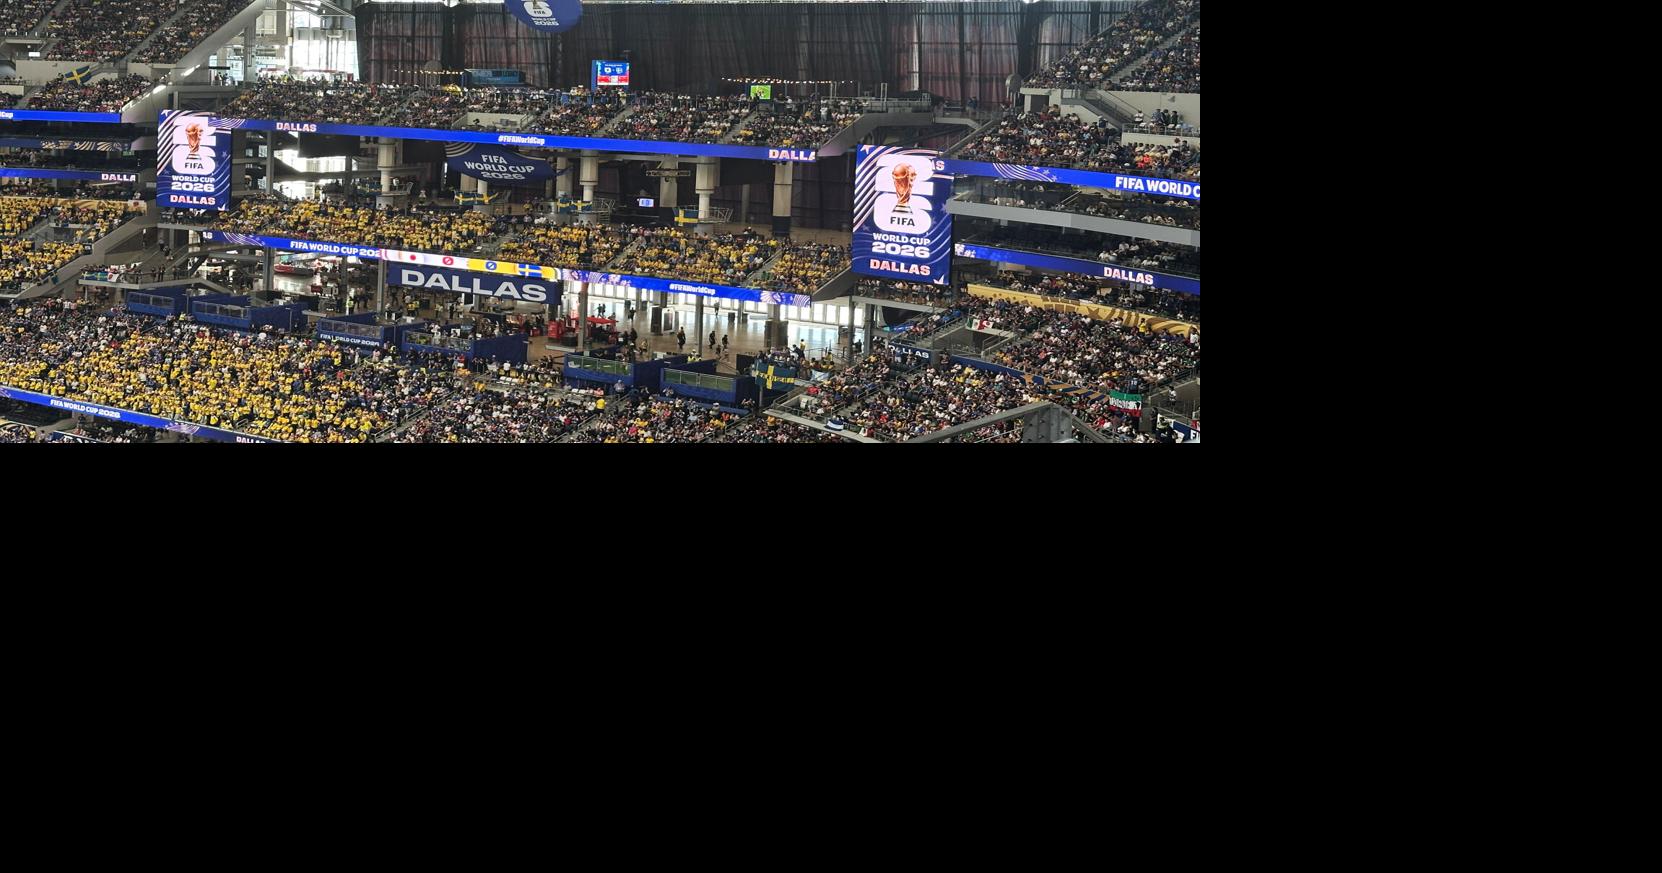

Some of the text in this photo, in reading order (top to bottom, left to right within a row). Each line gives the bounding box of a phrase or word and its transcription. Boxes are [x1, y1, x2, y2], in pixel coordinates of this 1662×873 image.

[276, 122, 317, 132] DALLAS
[498, 135, 545, 146] #FIFAWorldCup
[184, 162, 204, 170] FIFA
[481, 154, 508, 165] FIFA
[464, 161, 535, 174] WORLD CUP
[480, 171, 526, 180] 2026
[171, 181, 215, 192] 2026
[1115, 176, 1145, 191] FIFA
[1146, 179, 1192, 196] WORLD
[170, 195, 216, 205] DALLAS
[890, 216, 915, 227] FIFA
[872, 232, 931, 246] WORLD CUP
[290, 241, 309, 250] FIFA
[309, 242, 340, 253] WORLD
[341, 246, 359, 255] CUP
[871, 241, 931, 259] 2026
[869, 258, 931, 276] DALLAS
[1103, 266, 1154, 285] DALLAS
[401, 269, 547, 301] DALLAS
[669, 283, 716, 296] #FIFAWorldCup
[50, 399, 121, 419] FIFA WORLD CUP 2026
